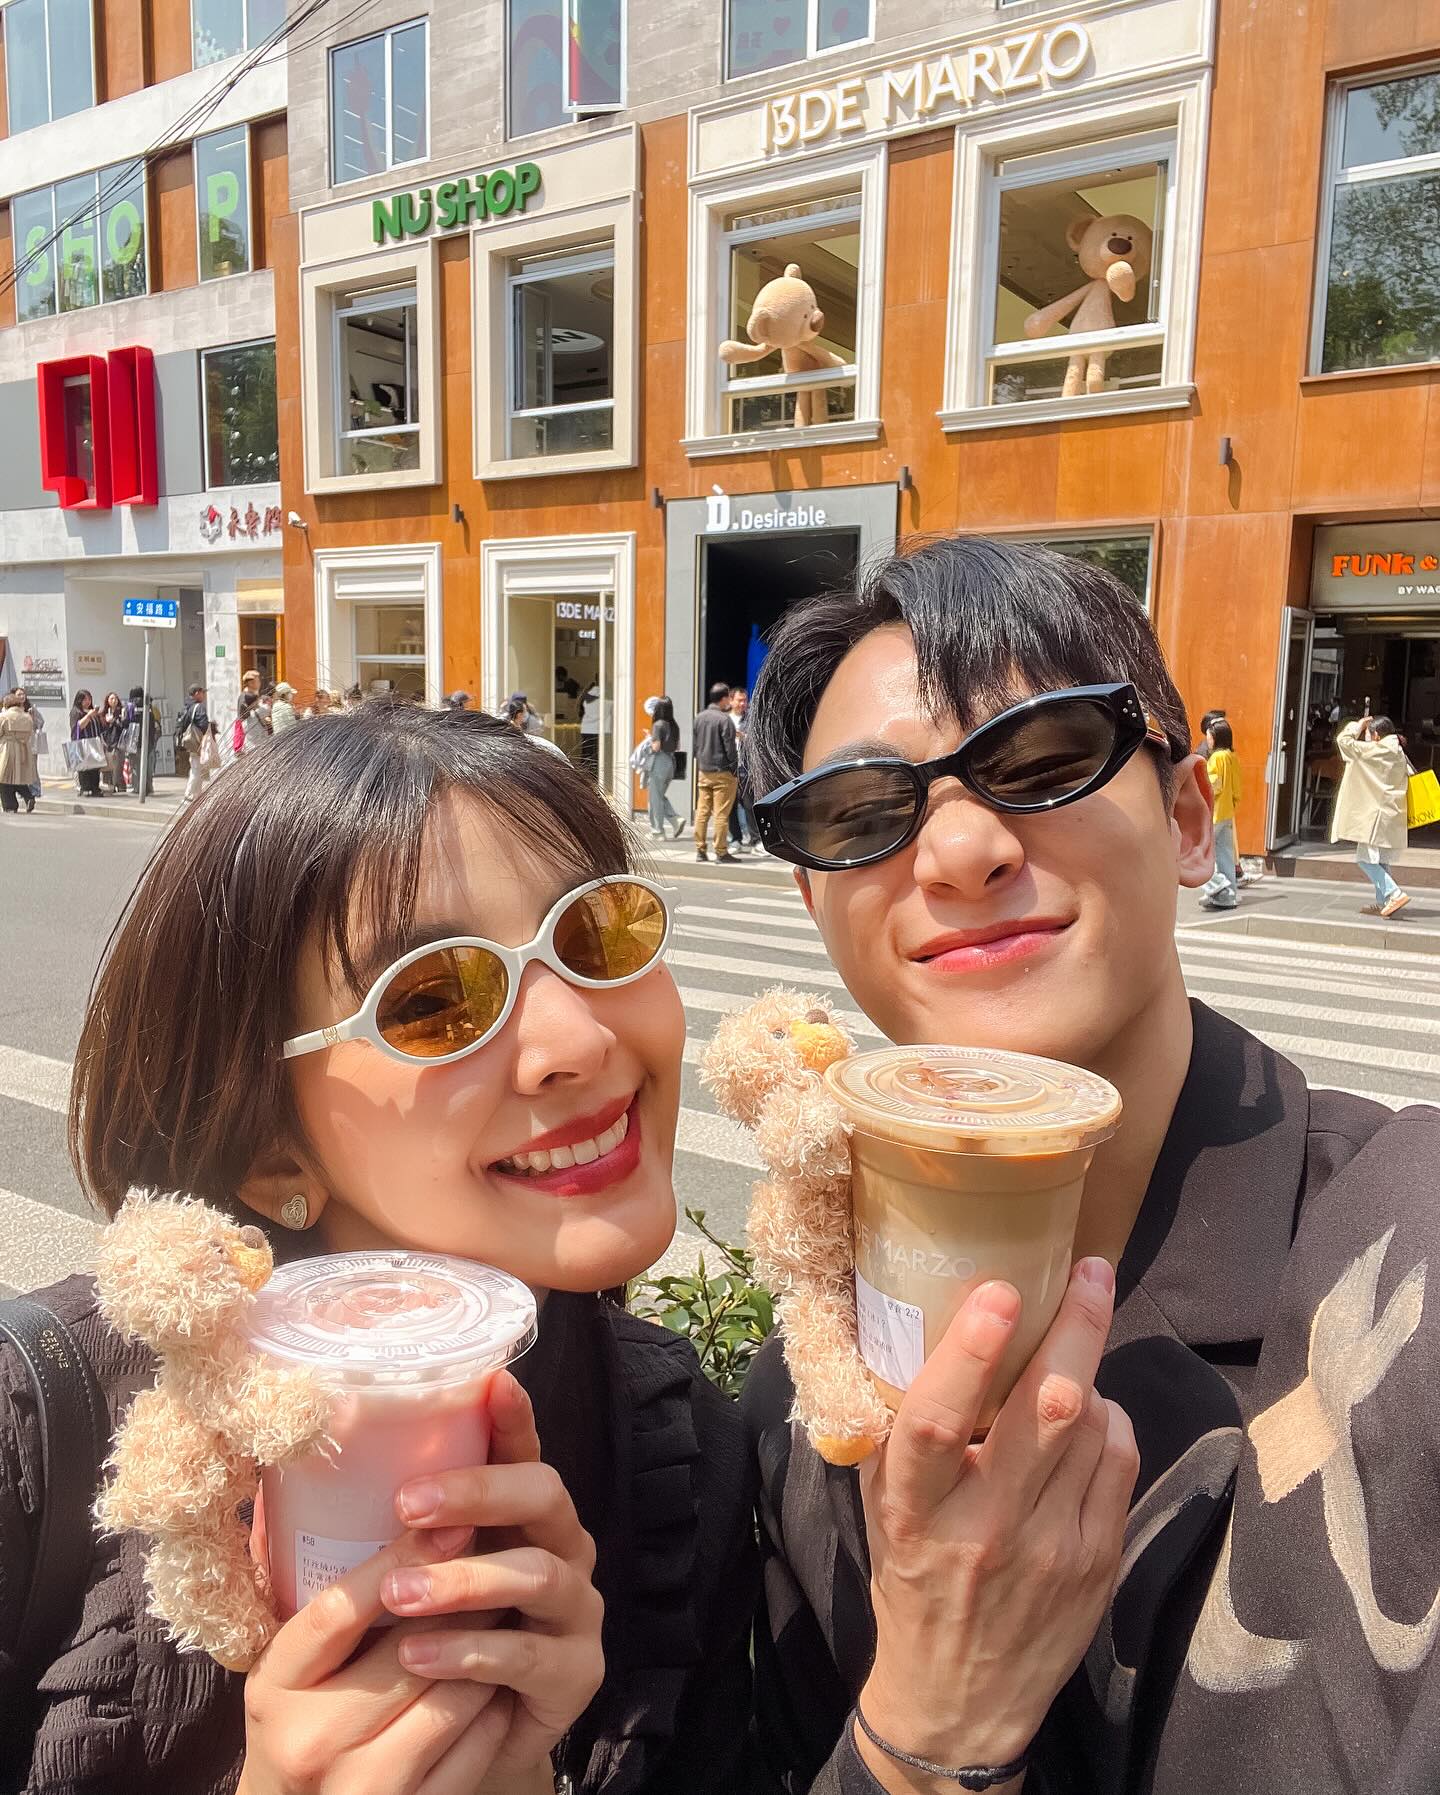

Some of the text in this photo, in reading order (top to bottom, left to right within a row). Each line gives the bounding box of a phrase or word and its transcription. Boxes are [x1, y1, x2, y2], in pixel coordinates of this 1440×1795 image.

[881, 22, 1089, 121] MARZO
[741, 505, 826, 530] Desirable
[1420, 554, 1438, 571] &
[1398, 586, 1414, 595] BY
[875, 1233, 977, 1281] MARZO
[43, 1329, 69, 1369] CELINE
